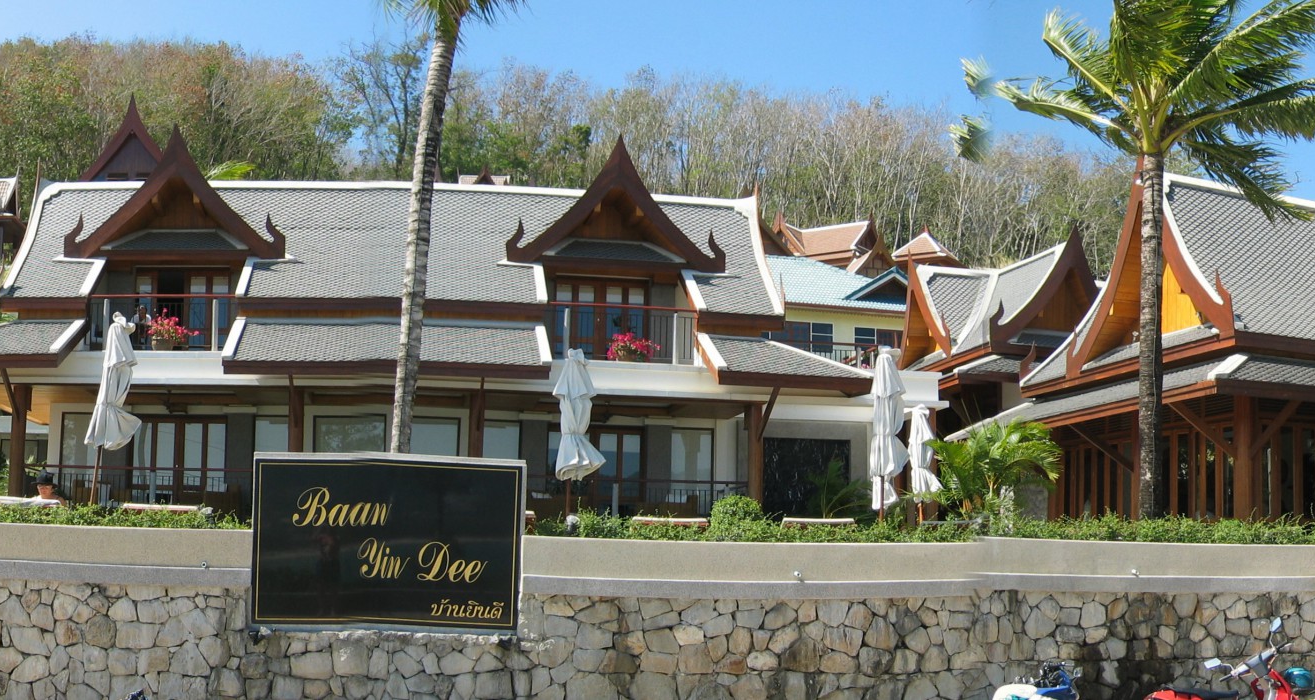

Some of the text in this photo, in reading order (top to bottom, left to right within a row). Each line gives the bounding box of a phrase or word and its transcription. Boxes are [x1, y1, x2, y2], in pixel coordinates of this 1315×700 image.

[292, 486, 391, 527] Baan
[357, 538, 488, 583] Yin Dee
[430, 599, 505, 619] บ้านยินดี
